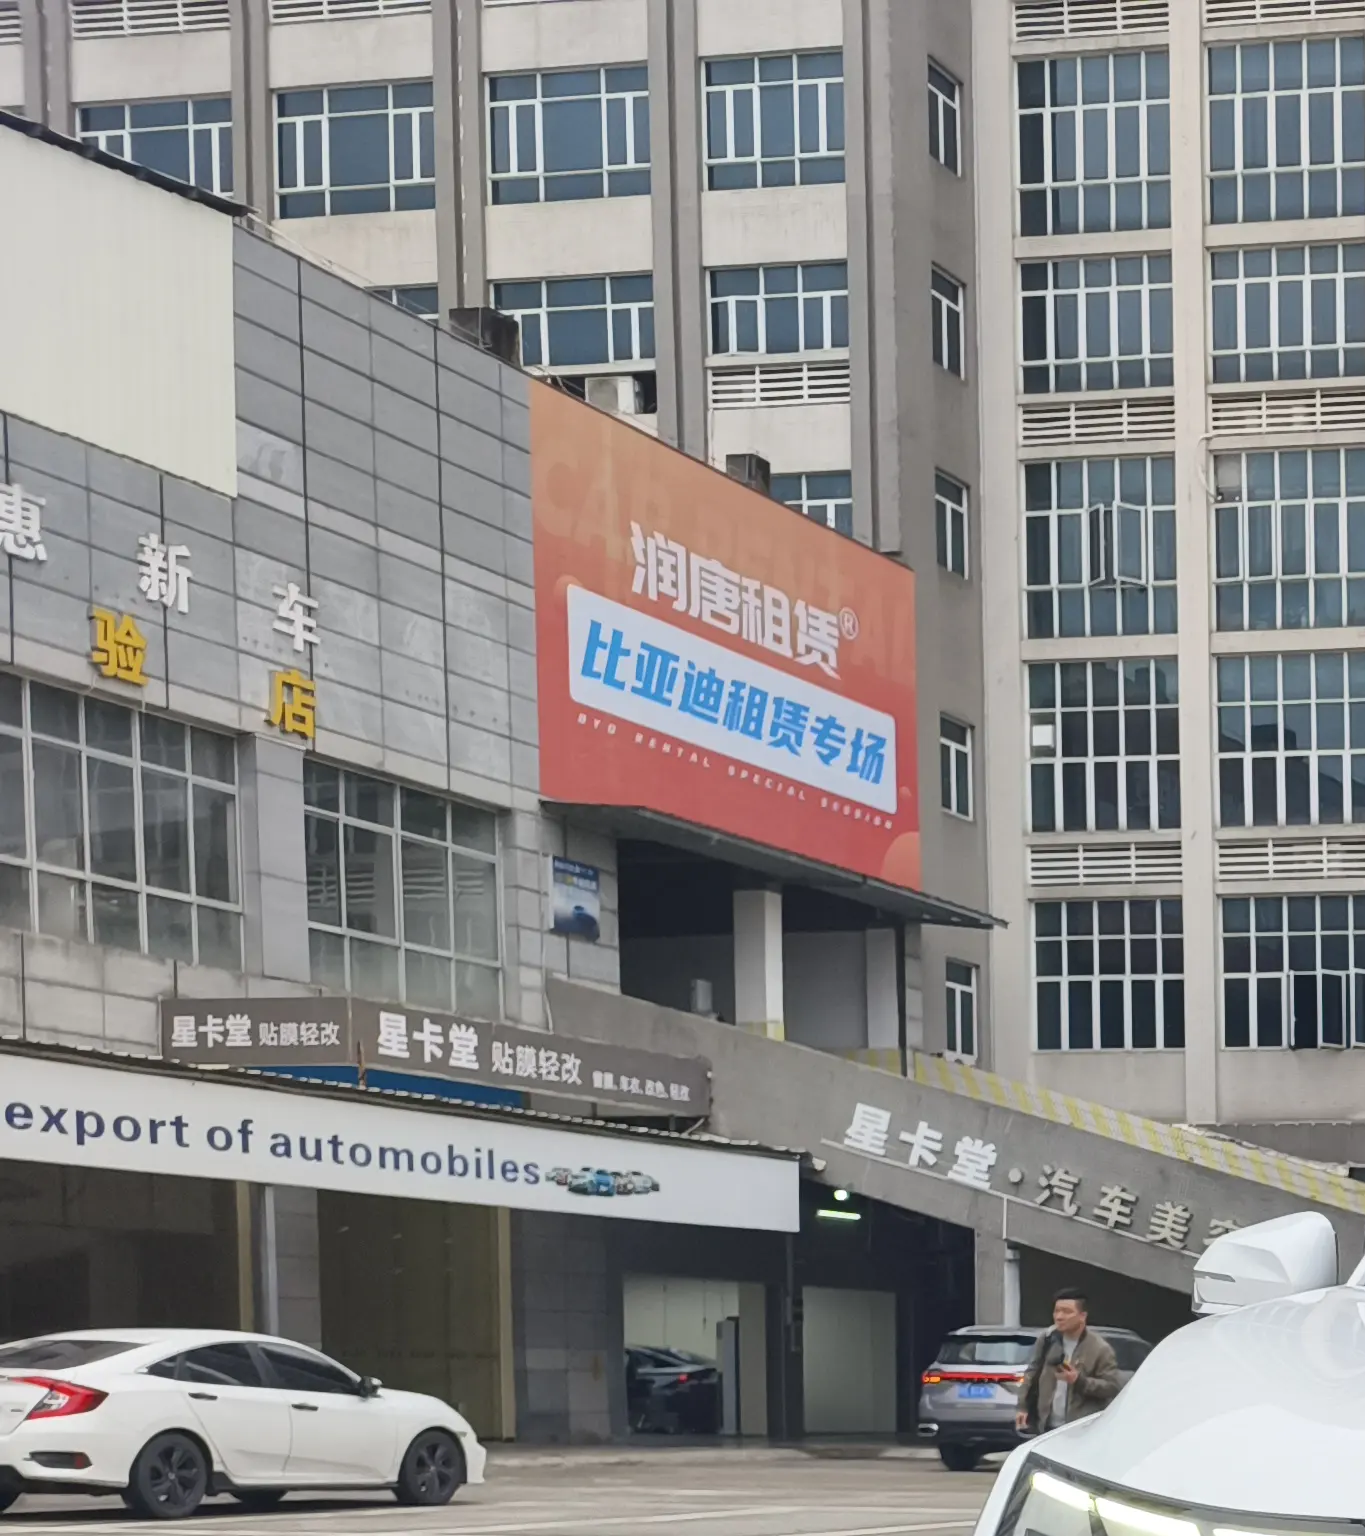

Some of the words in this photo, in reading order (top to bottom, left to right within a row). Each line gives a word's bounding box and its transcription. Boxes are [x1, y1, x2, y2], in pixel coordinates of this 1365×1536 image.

[90, 607, 317, 739] 验店
[580, 619, 888, 786] 比亚迪租赁专场
[576, 712, 618, 736] BYD
[634, 732, 711, 768] RENTAL
[727, 764, 806, 801] SPECIAL
[171, 1013, 253, 1048] 星卡堂
[258, 1021, 341, 1046] 贴膜轻改
[377, 1010, 480, 1070] 星卡堂
[491, 1041, 583, 1085] 贴膜轻改
[3, 1100, 190, 1148] export
[206, 1119, 254, 1154] of
[269, 1130, 541, 1185] automobiles
